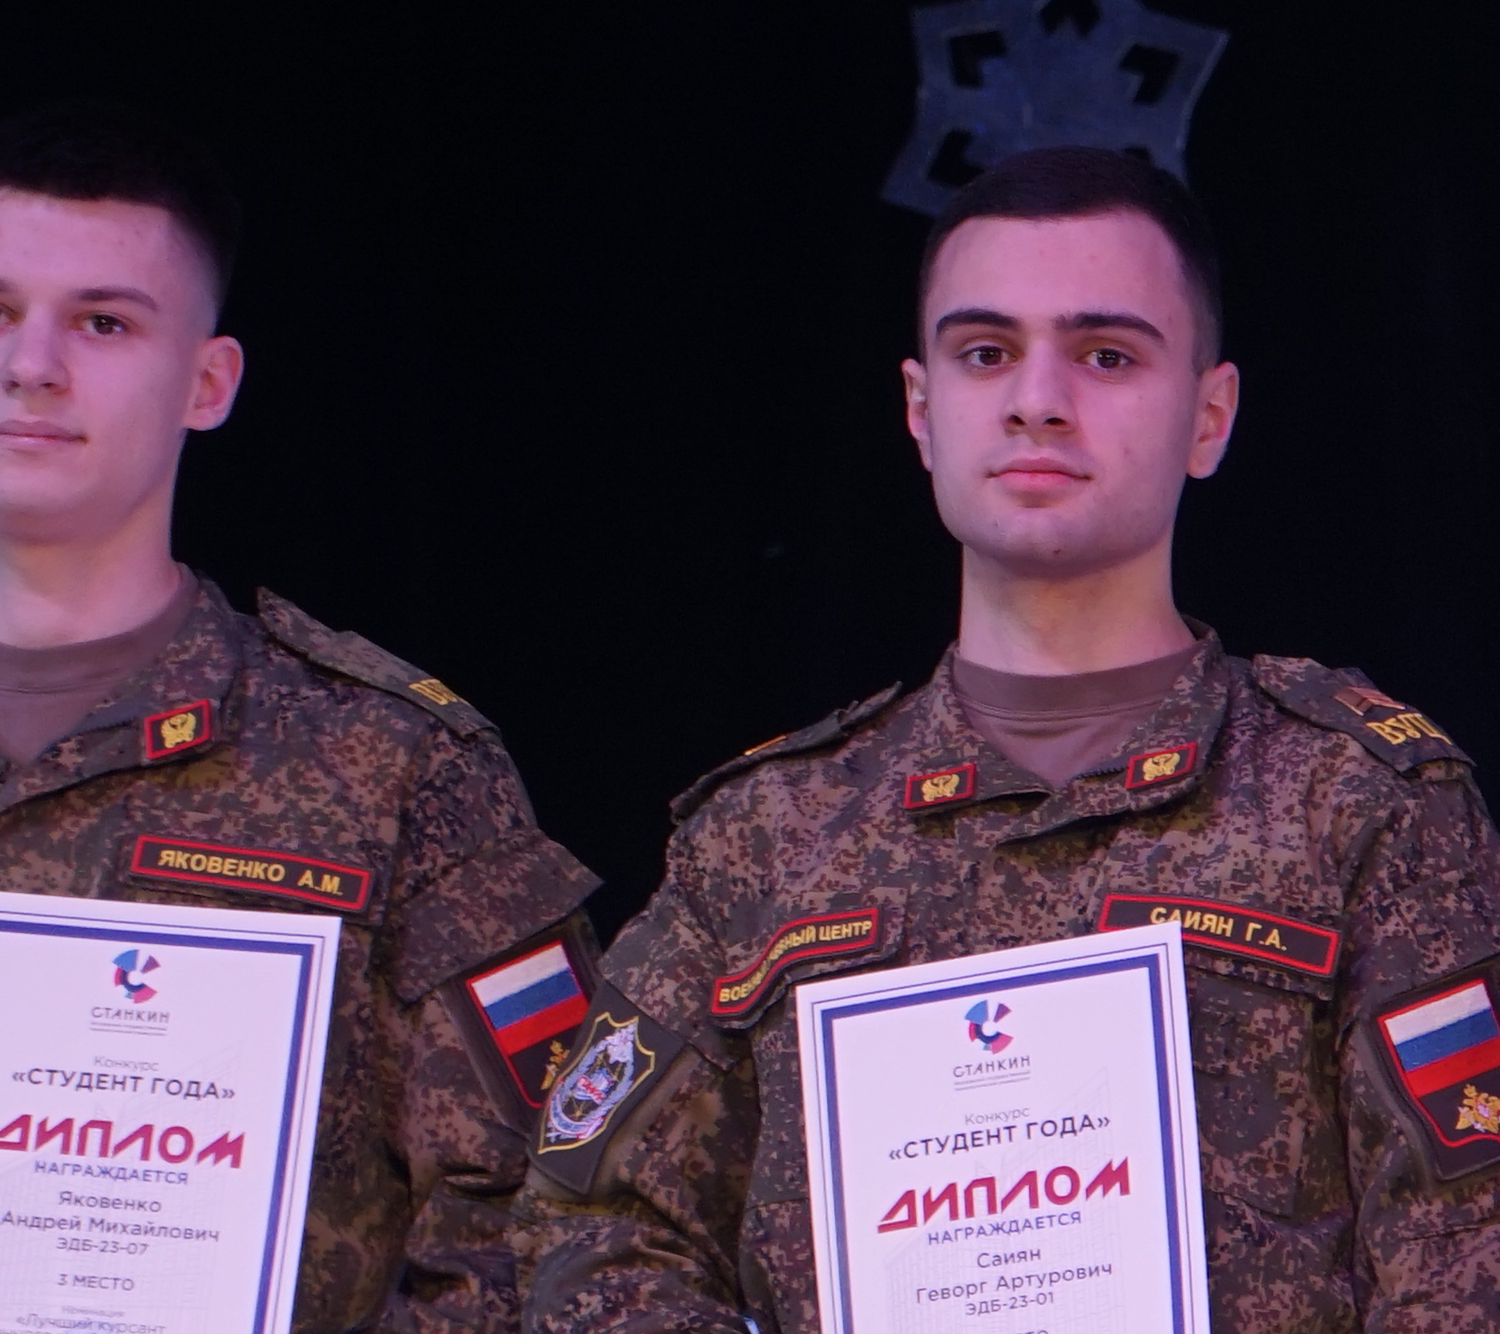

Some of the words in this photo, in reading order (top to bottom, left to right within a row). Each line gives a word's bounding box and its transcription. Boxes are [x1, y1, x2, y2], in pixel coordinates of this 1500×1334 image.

[158, 850, 286, 882] ЯКОВЕНКО
[297, 869, 343, 896] А.М.
[818, 921, 873, 941] ЦЕНТР
[1150, 907, 1234, 938] САИЯН
[1245, 922, 1287, 951] Г.А.
[90, 1006, 170, 1023] СТАНКИН
[94, 1056, 159, 1072] Конкурс
[953, 1055, 1031, 1078] СТАНКИН
[12, 1067, 143, 1093] «СТУДЕНТ
[151, 1077, 235, 1100] ГОДА»
[965, 1108, 1030, 1126] Конкурс
[889, 1124, 1018, 1162] «СТУДЕНТ
[1026, 1113, 1111, 1138] ГОДА»
[34, 1159, 188, 1186] НАГРАЖДАЕТСЯ
[58, 1191, 162, 1213] Яковенко
[877, 1156, 1131, 1233] ДИПЛОМ
[1, 1210, 81, 1233] Андрей
[88, 1215, 220, 1243] Михайлович
[928, 1210, 1081, 1246] НАГРАЖДАЕТСЯ
[56, 1237, 148, 1256] ЭДБ-23-07
[976, 1246, 1042, 1269] Саиян
[57, 1273, 68, 1287] 3
[72, 1275, 134, 1292] МЕСТО
[915, 1280, 989, 1305] Геворг
[997, 1262, 1113, 1293] Артурович
[965, 1292, 1056, 1317] ЭДБ-23-01
